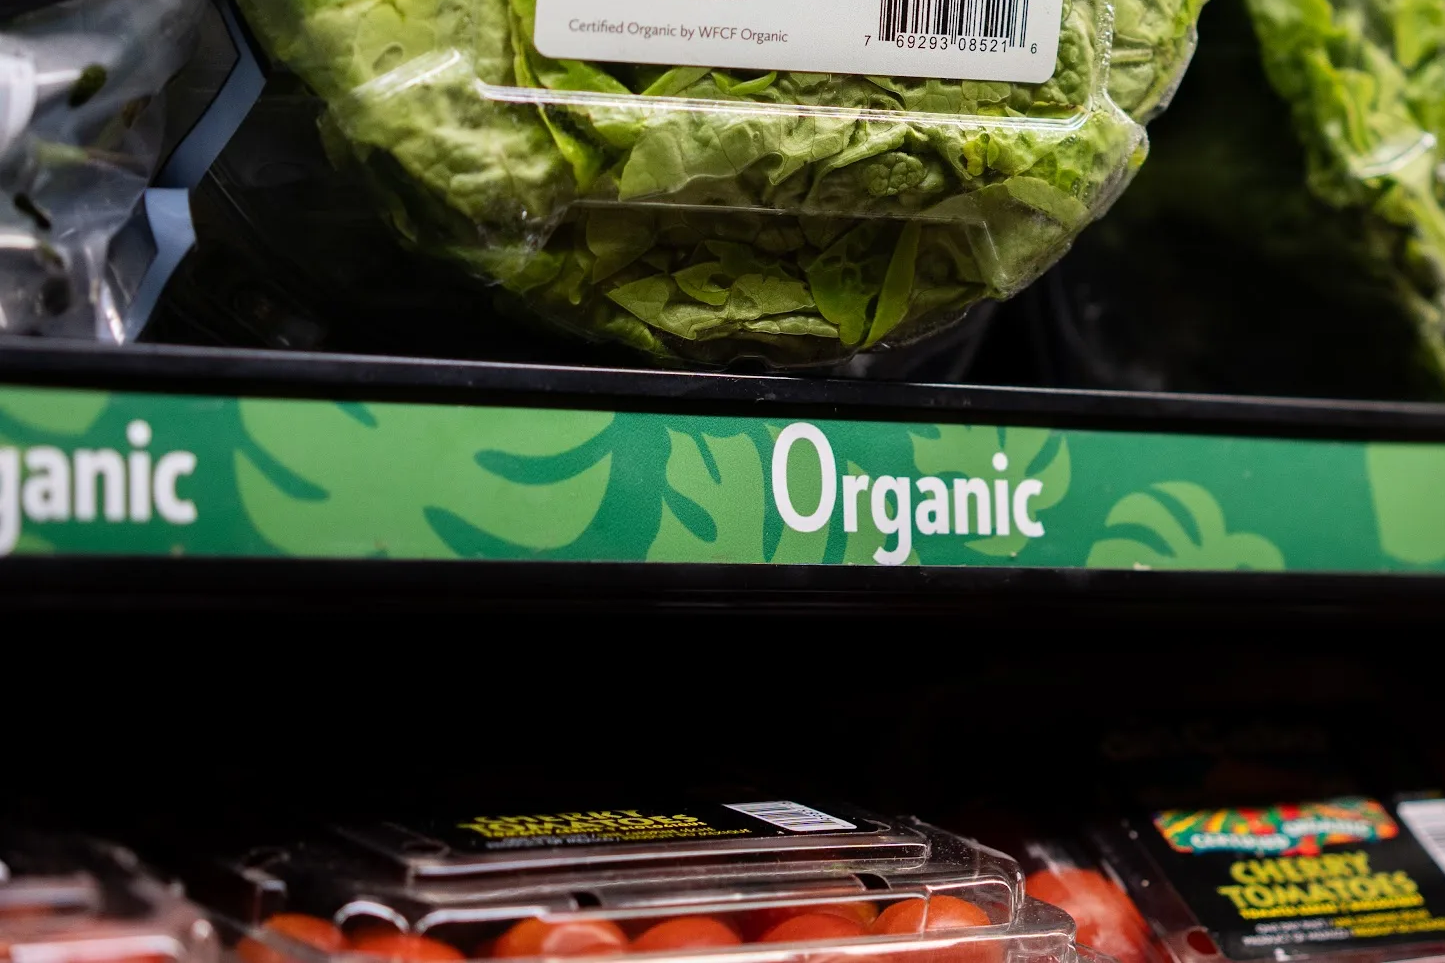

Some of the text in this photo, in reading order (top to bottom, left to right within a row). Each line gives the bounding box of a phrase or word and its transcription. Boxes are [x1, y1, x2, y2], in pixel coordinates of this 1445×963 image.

[568, 18, 788, 44] Certified Organic by WFCF Organic
[865, 34, 1037, 54] 7 69293 08521 6
[772, 422, 1045, 565] Organic
[456, 814, 699, 835] TOMATOES
[473, 809, 643, 825] CHERRY
[1230, 850, 1370, 885] CHERRY
[1217, 870, 1419, 909] TOMATOES
